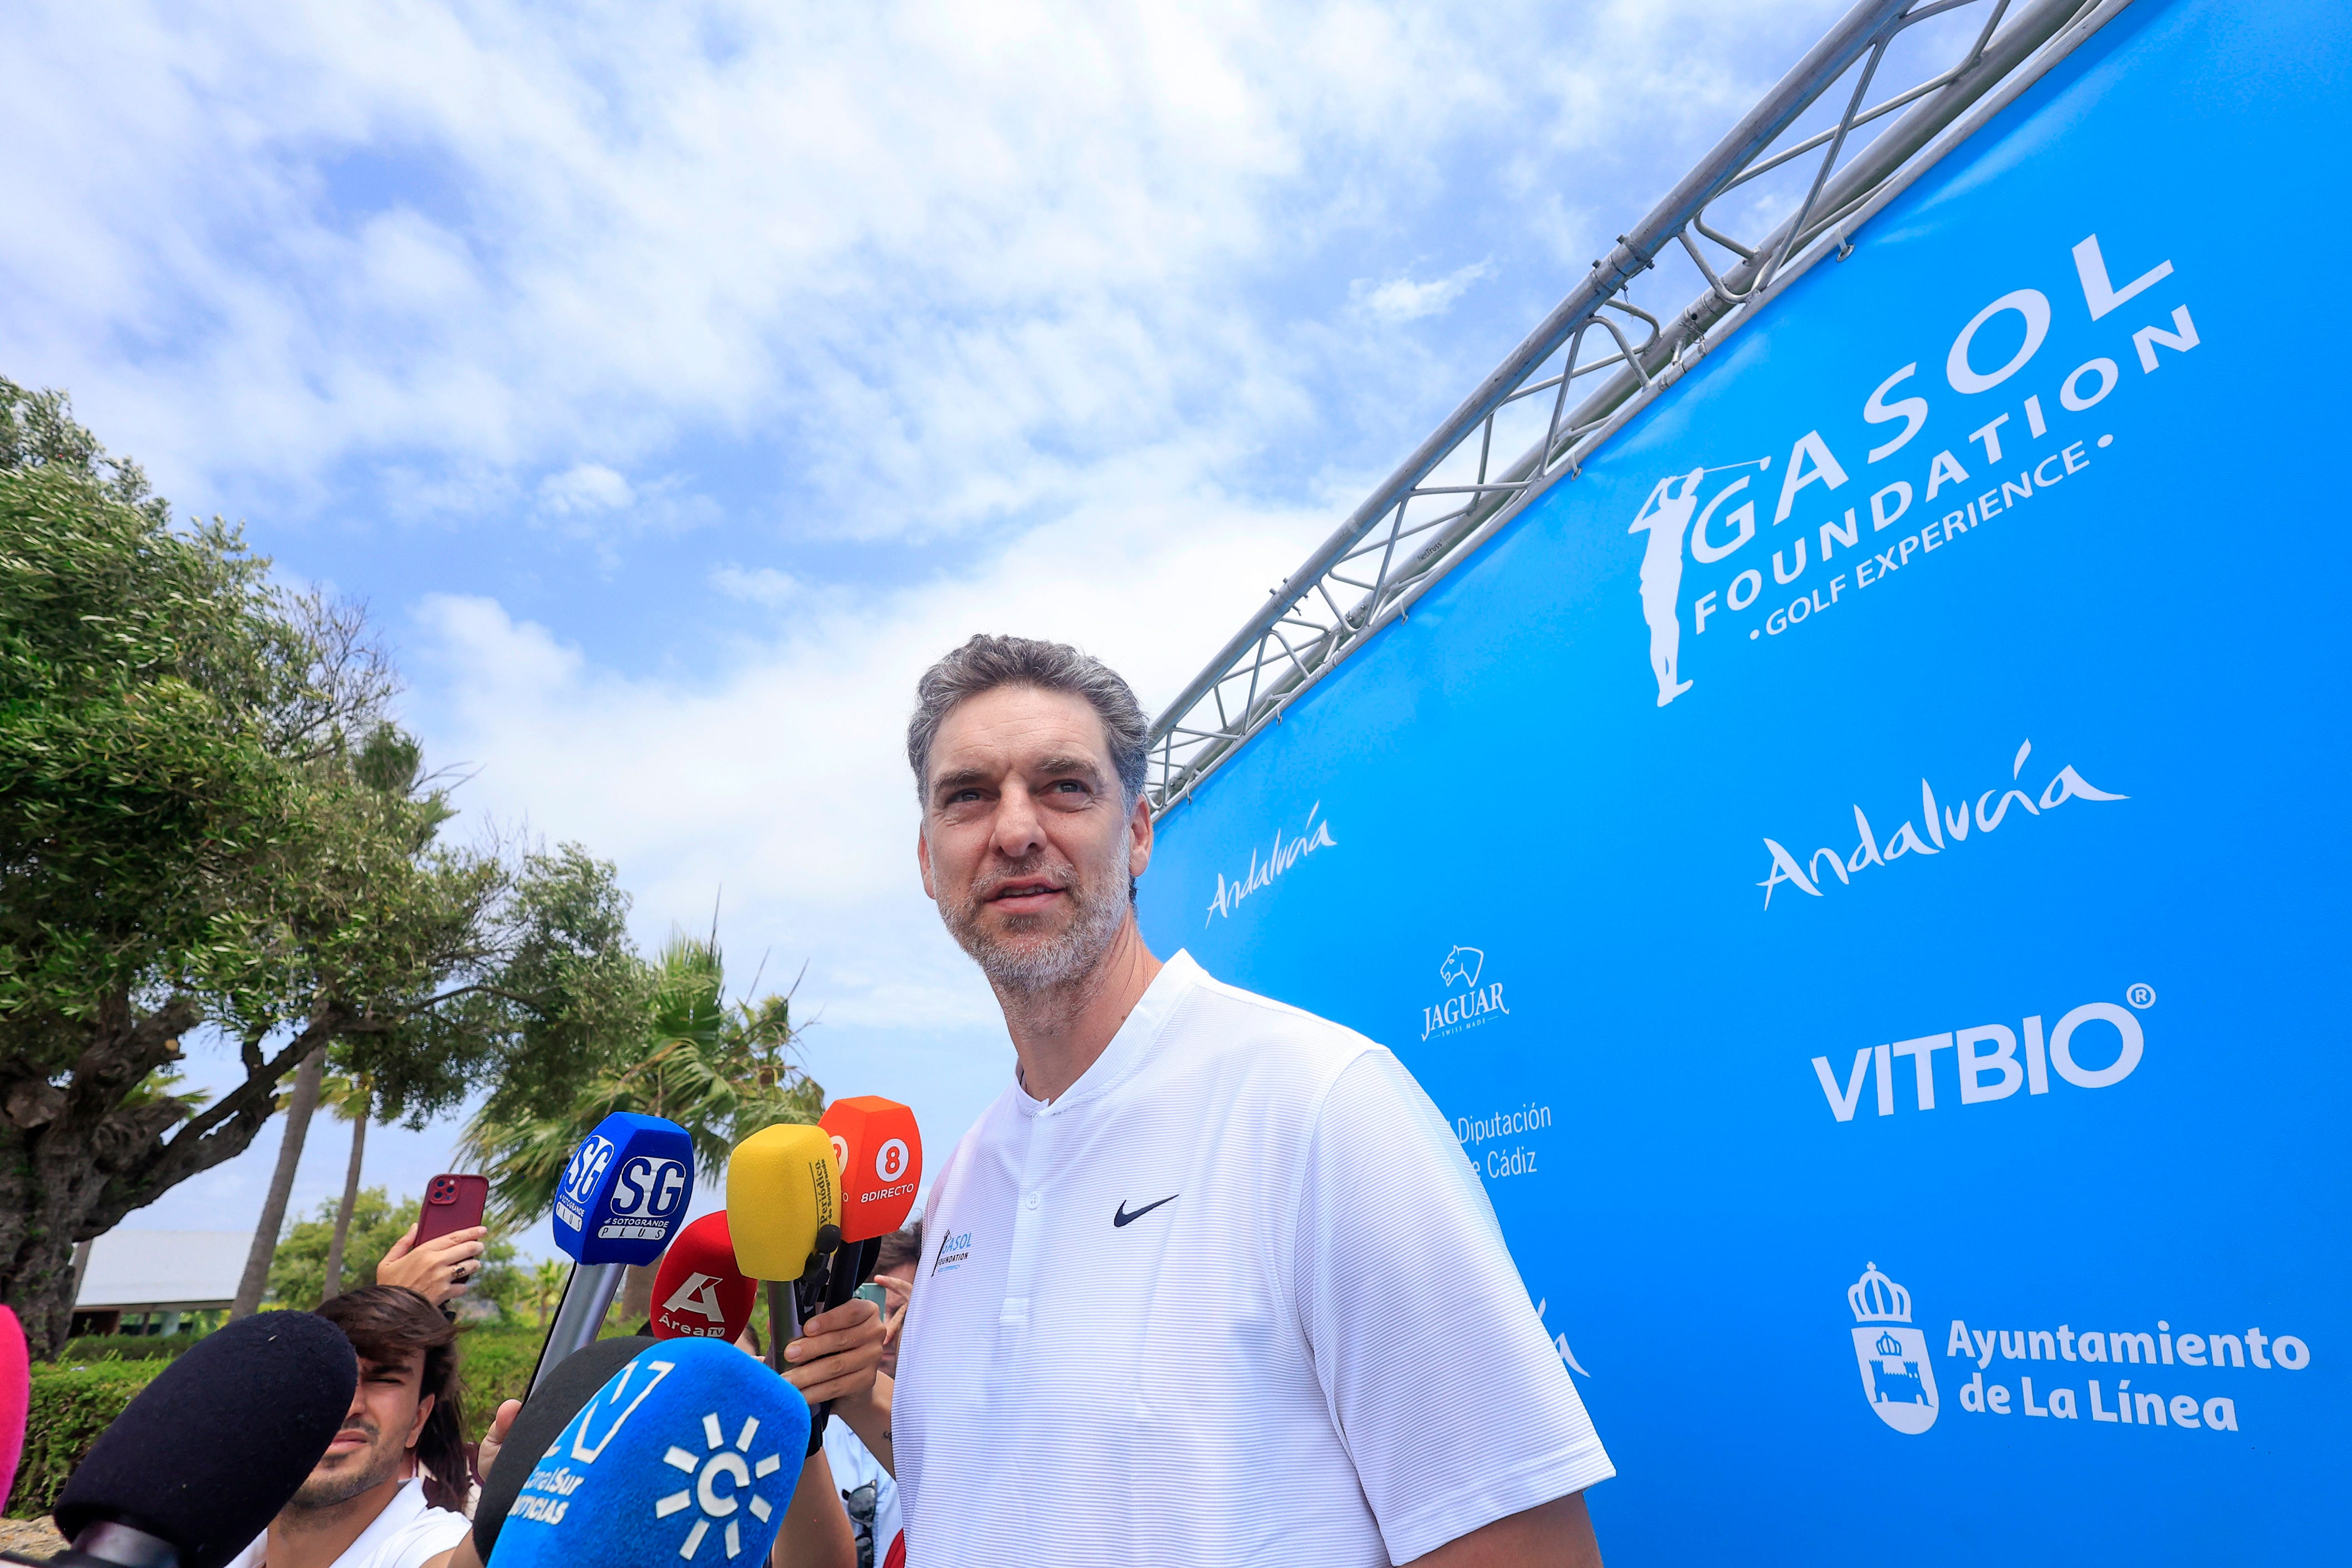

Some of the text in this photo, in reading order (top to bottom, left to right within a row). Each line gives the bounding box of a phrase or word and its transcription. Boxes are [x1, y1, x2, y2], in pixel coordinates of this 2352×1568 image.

[1691, 234, 2173, 563] GASOL
[1696, 305, 2200, 634] FOUNDATION
[1766, 440, 2089, 635] GOLF EXPERIENCE
[1756, 738, 2130, 911] Andalucía
[1205, 800, 1337, 930] Andalucía
[1421, 982, 1510, 1042] JAGUAR
[1442, 1018, 1486, 1037] SWISS MADE
[1458, 1102, 1551, 1146] Diputación
[885, 1146, 900, 1174] 8
[1487, 1146, 1537, 1179] Cádiz
[612, 1157, 686, 1216] SG
[861, 1183, 914, 1203] 8DIRECTO
[601, 1227, 662, 1239] PLUS
[612, 1218, 669, 1228] SOTOGRANDE
[942, 1232, 971, 1254] GASOL
[658, 1313, 704, 1336] Área
[1947, 1320, 2310, 1370] Ayuntamiento
[1960, 1373, 2238, 1431] de La Línea
